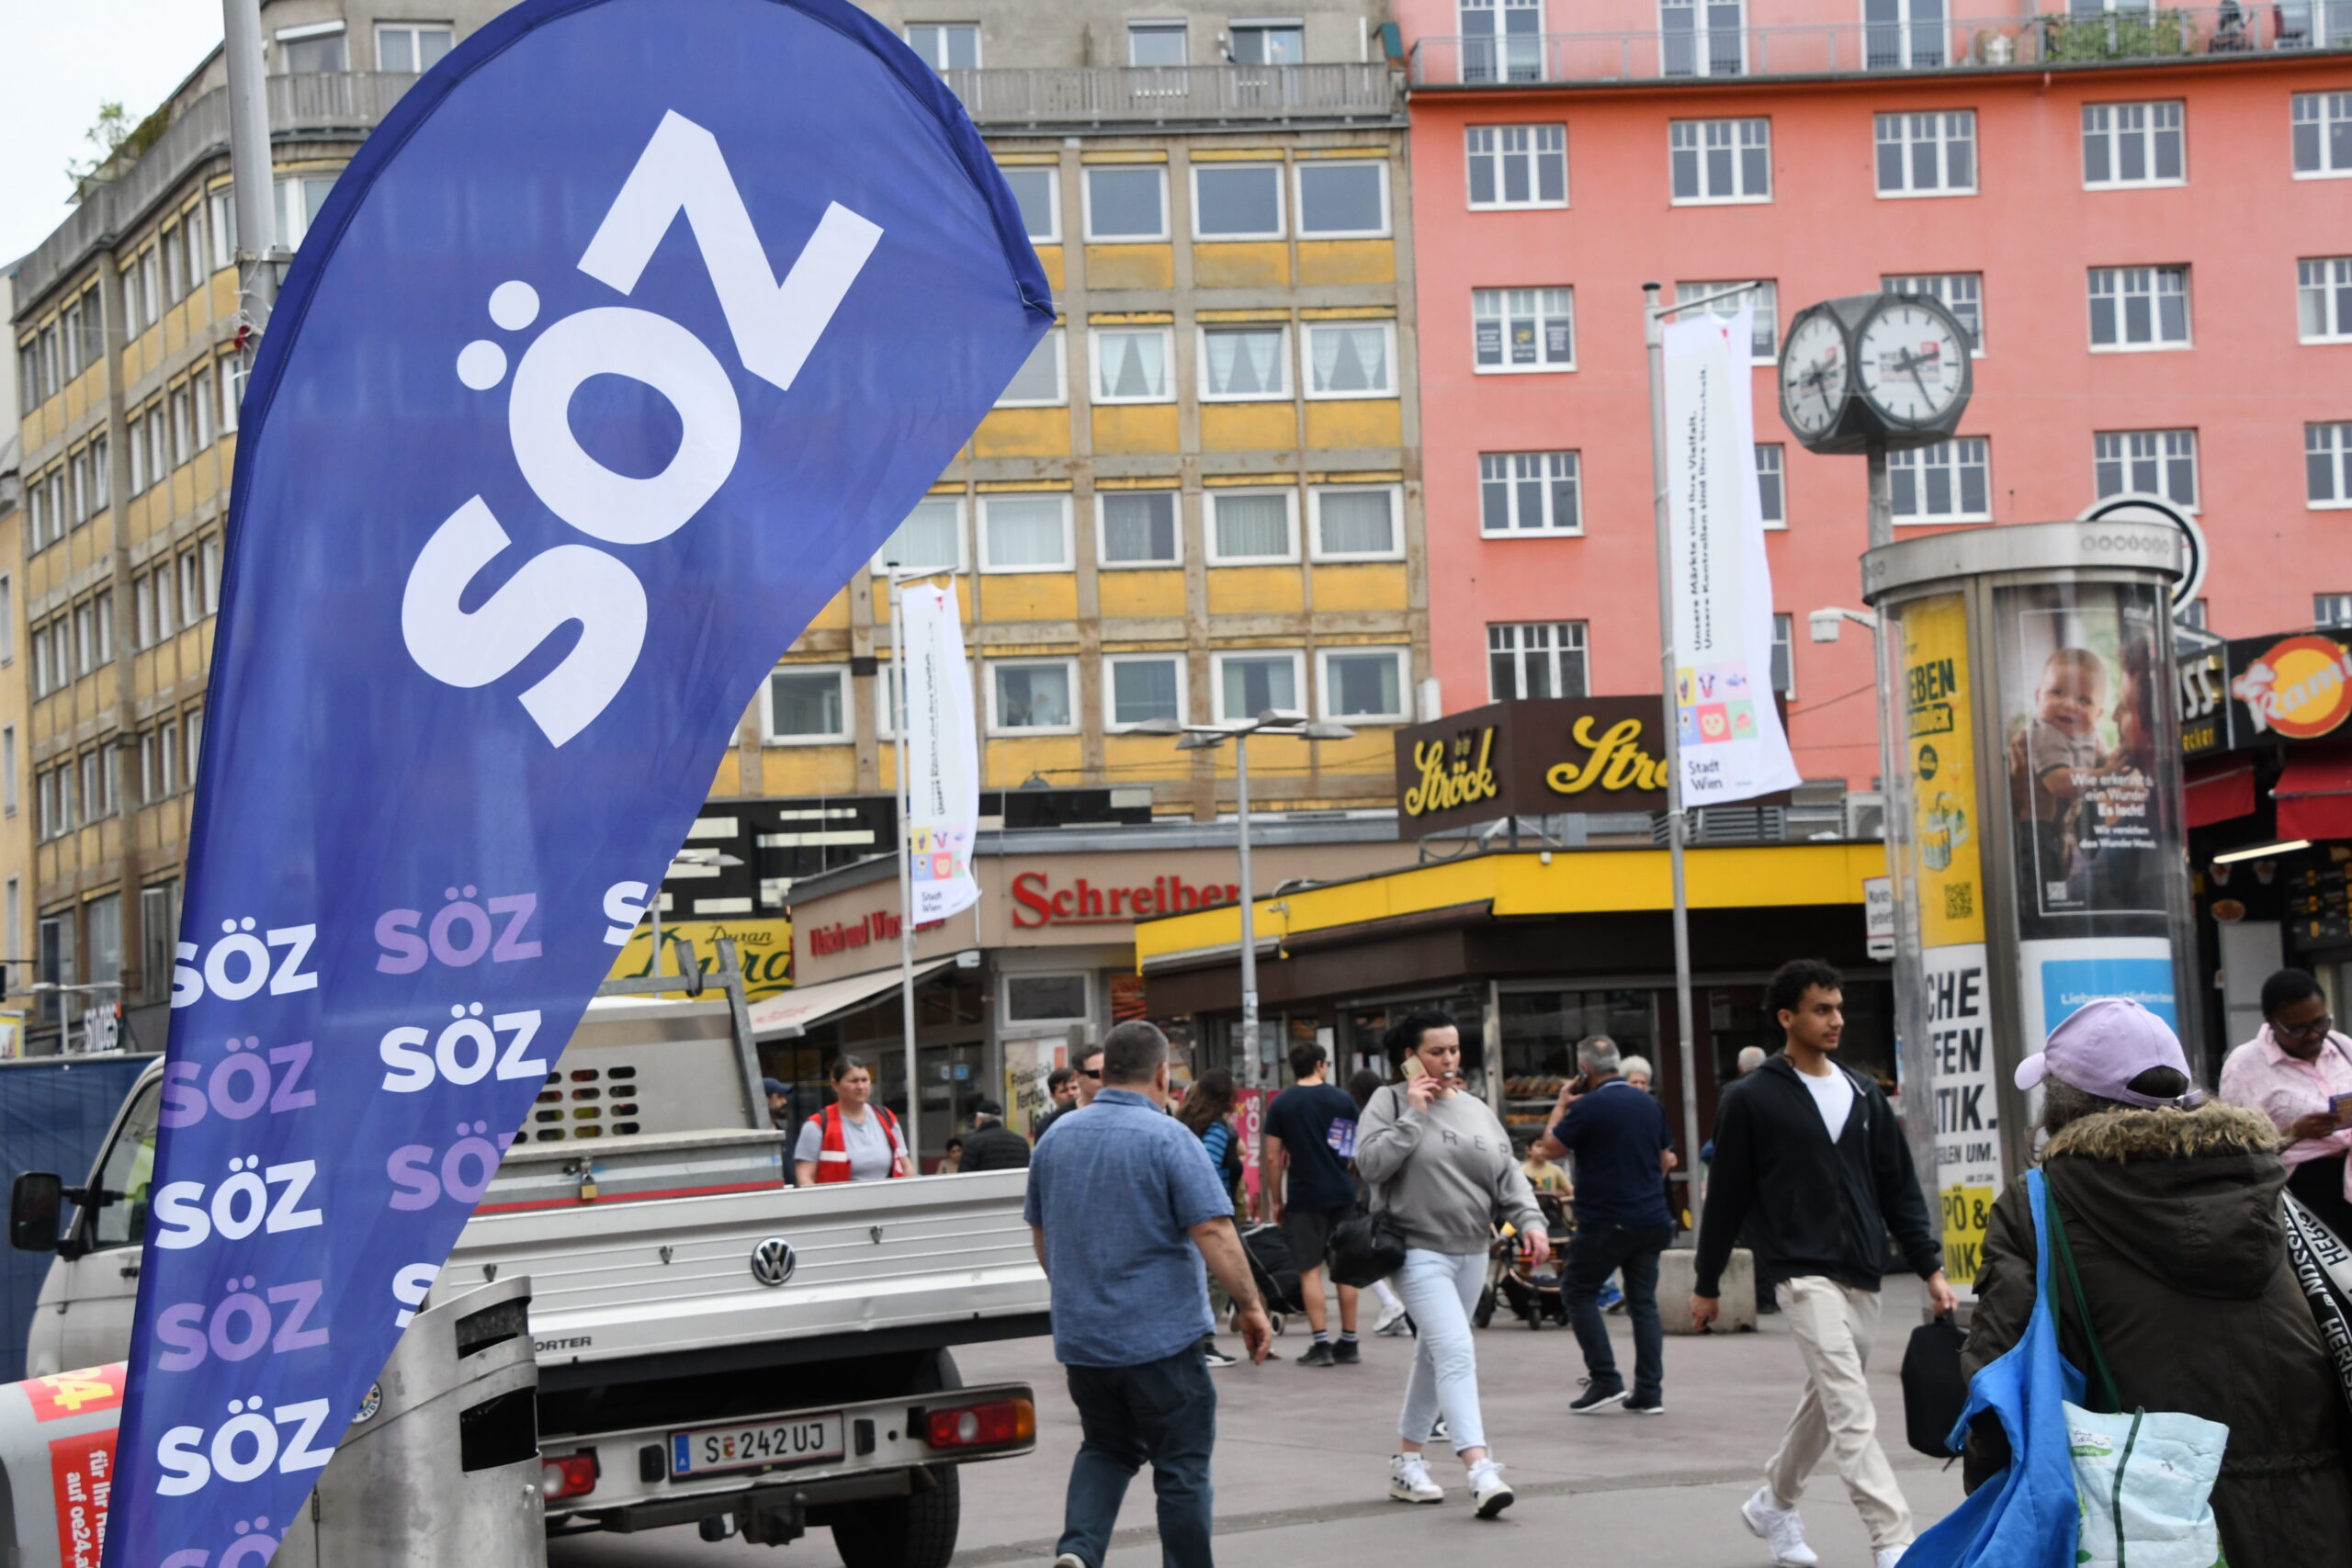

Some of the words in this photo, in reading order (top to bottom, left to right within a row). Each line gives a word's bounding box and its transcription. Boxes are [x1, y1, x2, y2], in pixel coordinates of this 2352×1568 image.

[401, 108, 884, 748] SÖZ
[1692, 600, 1702, 650] Unsere
[1702, 598, 1713, 649] Unsere
[1405, 728, 1496, 816] Ströck
[1689, 759, 1720, 775] Stadt
[1690, 776, 1723, 791] Wien
[375, 884, 543, 975] SÖZ
[706, 926, 774, 946] Duran
[1012, 872, 1241, 929] Schreiber
[172, 917, 318, 1009] SÖZ
[161, 1036, 316, 1128] SÖZ
[380, 1001, 547, 1093] SÖZ
[386, 1120, 515, 1211] SÖ
[1246, 1095, 1261, 1167] NEOS
[154, 1155, 322, 1249] SÖZ
[156, 1275, 330, 1372] SÖZ
[89, 1450, 109, 1479] für
[156, 1395, 335, 1496] SÖZ
[66, 1472, 87, 1503] auf
[93, 1482, 111, 1508] Ihr
